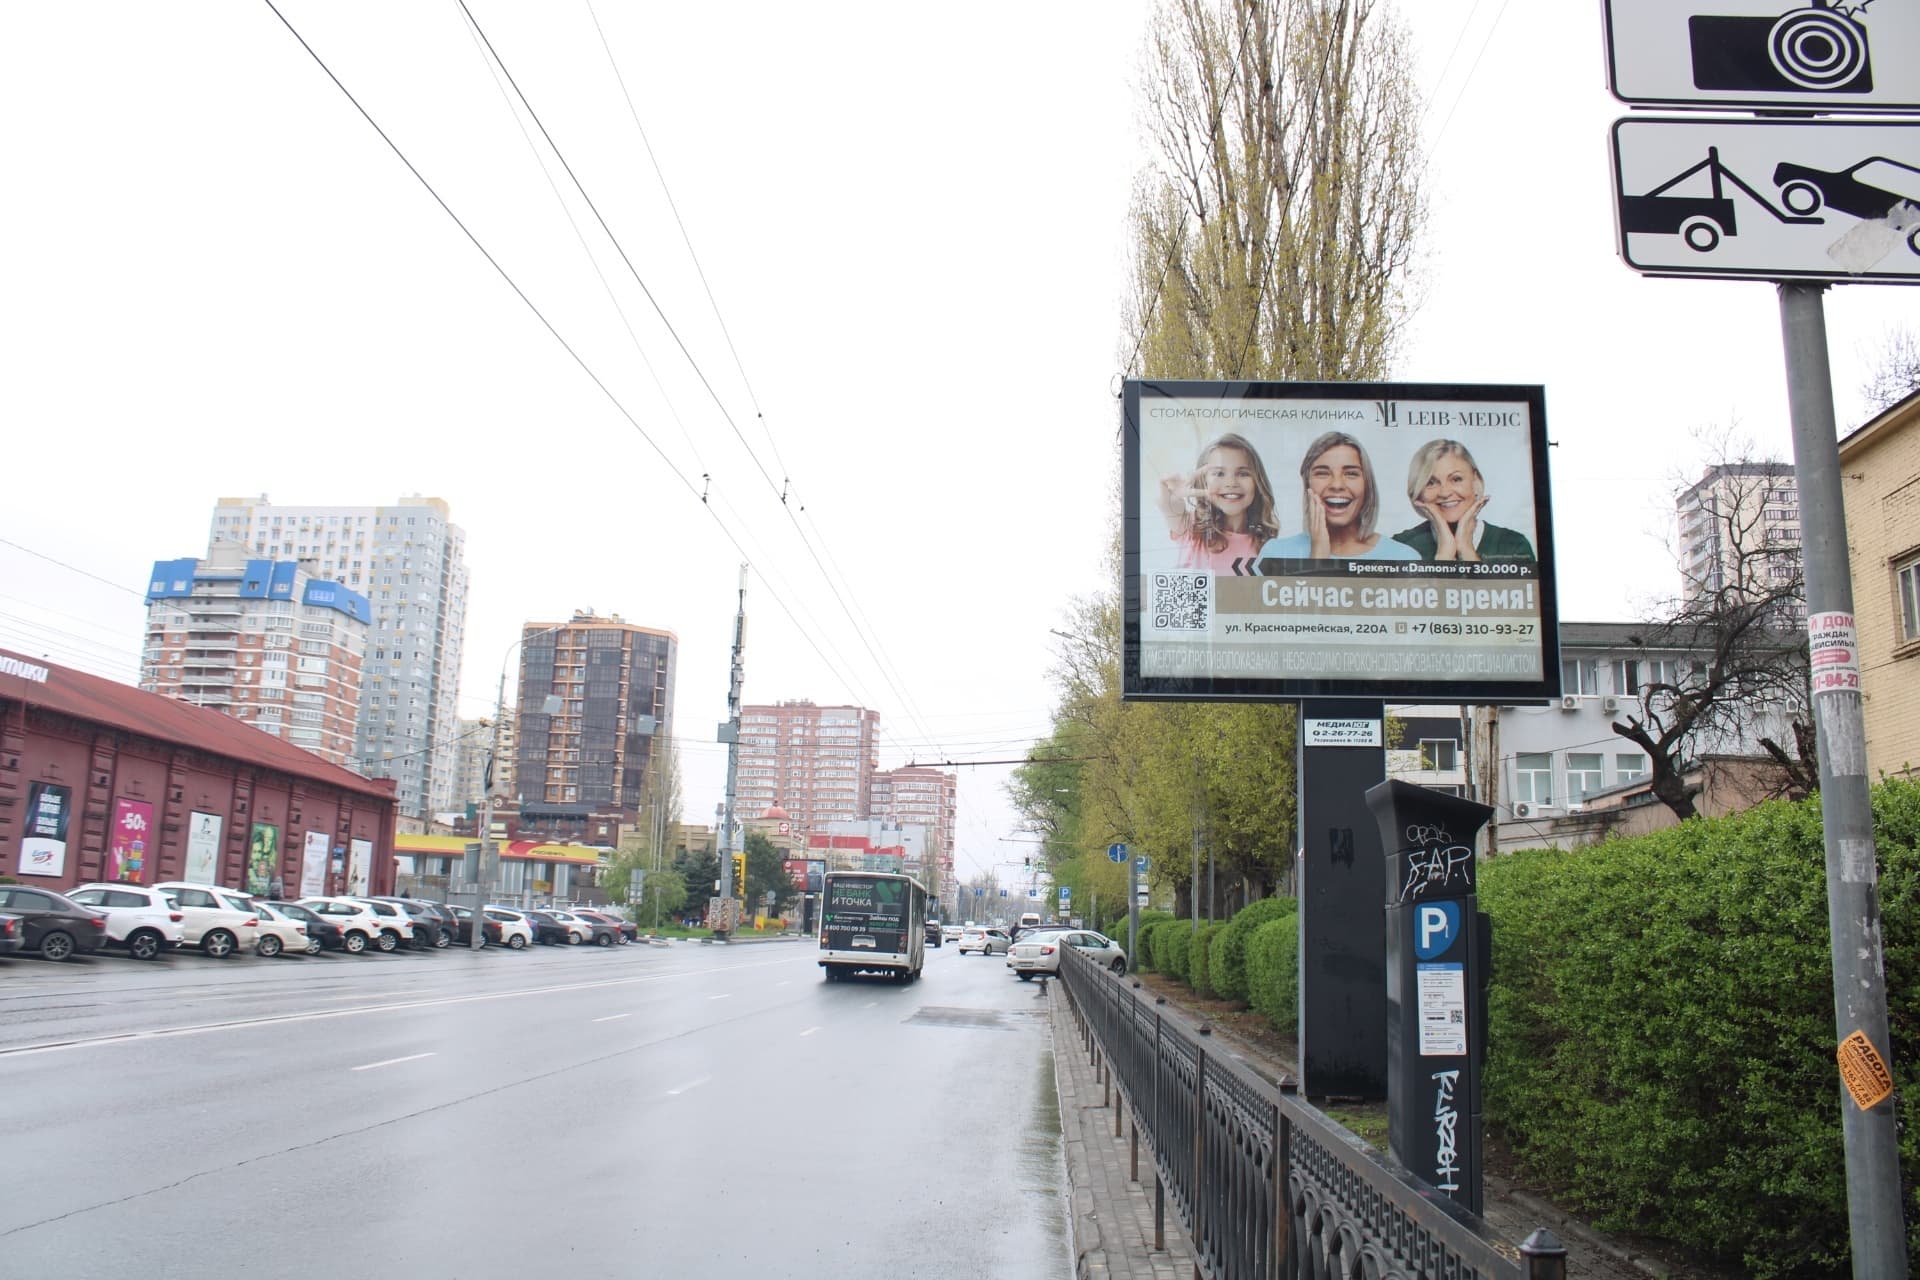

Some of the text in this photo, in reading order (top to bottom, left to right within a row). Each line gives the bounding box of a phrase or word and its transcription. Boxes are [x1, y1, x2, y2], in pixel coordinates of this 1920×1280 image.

[1150, 408, 1364, 420] СТОМАТОЛОГИЧЕСКАЯ КЛИНИКА
[1408, 410, 1521, 427] LEIB-MEDIC
[1348, 562, 1532, 576] Брекеты «Damon» от 30.000 р.
[1262, 579, 1534, 616] Сейчас самое время!
[1225, 623, 1388, 635] ул. Красноармейская, 220А
[1412, 622, 1535, 635] +7 (863) 310-93-27
[1284, 651, 1342, 672] НЕОБХОДИМО
[832, 889, 872, 898] НЕ БАНК
[832, 897, 872, 907] И ТОЧКА
[1421, 907, 1447, 949] P
[1853, 1036, 1891, 1089] РАБОТА
